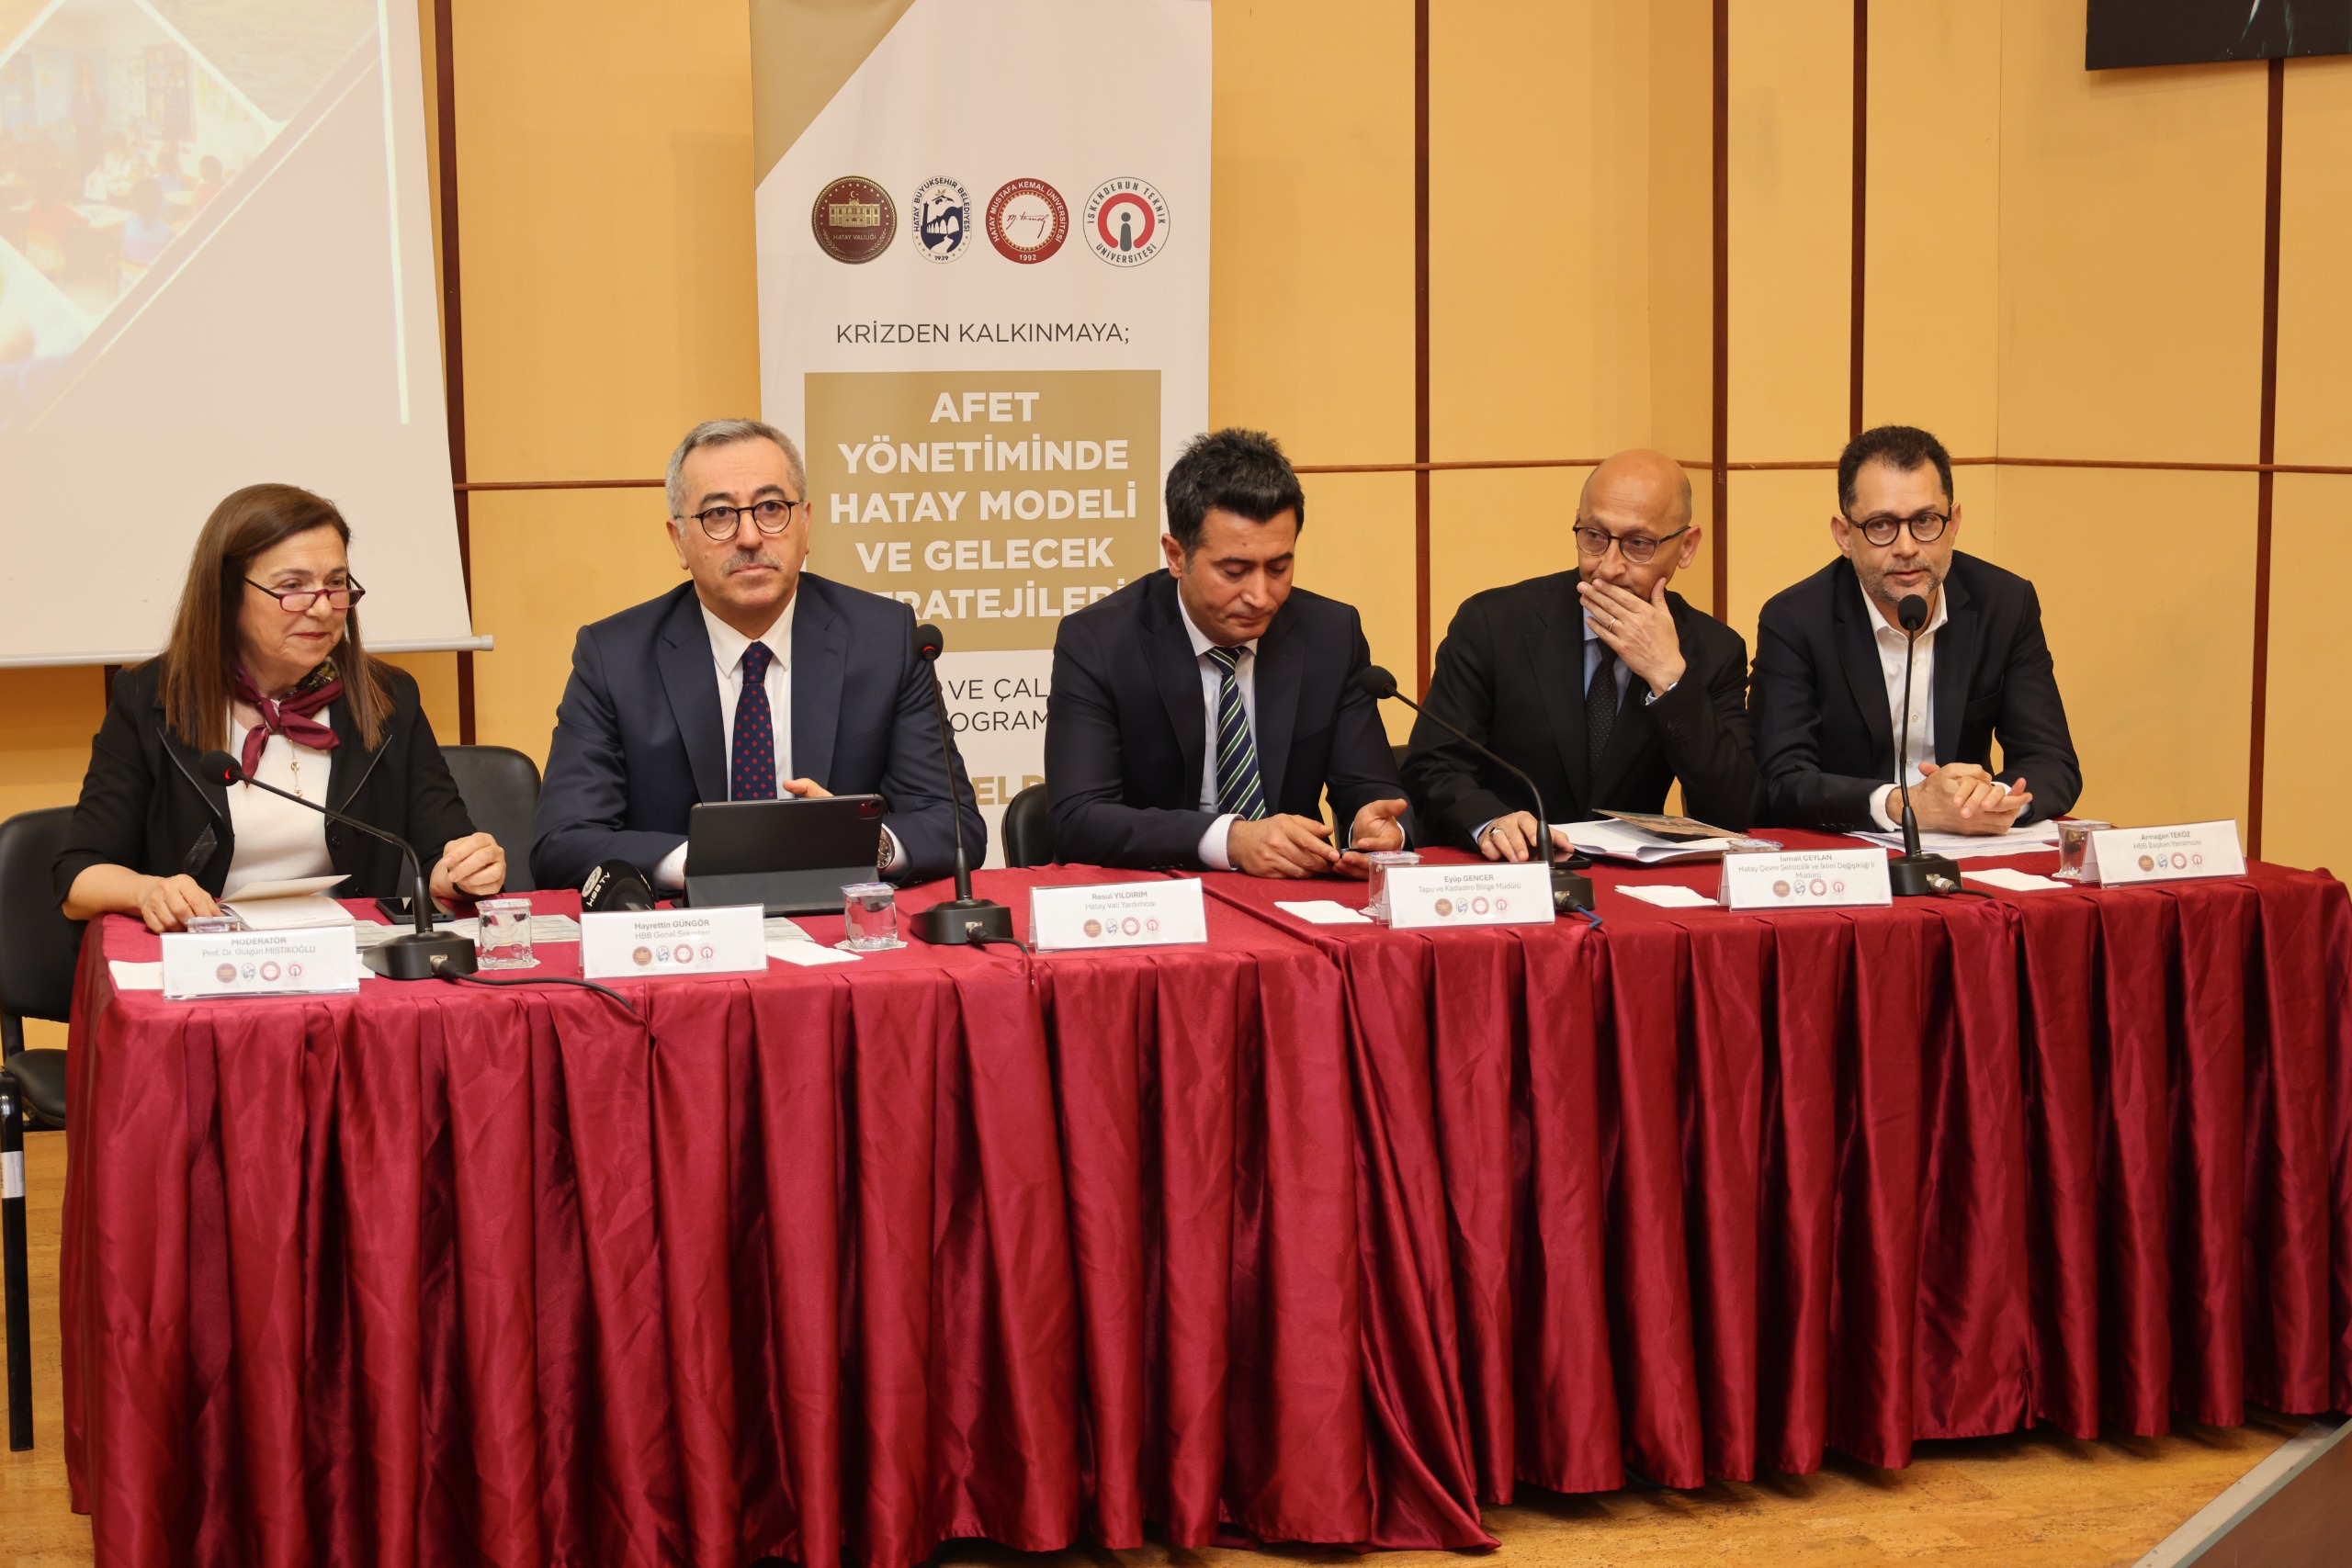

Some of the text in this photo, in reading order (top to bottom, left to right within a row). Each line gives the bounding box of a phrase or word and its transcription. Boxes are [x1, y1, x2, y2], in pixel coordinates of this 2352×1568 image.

[1018, 181, 1046, 193] KEMAL
[989, 184, 1018, 214] MUSTAFA
[989, 215, 1001, 243] HATAY
[837, 320, 1130, 344] KRİZDEN KALKINMAYA;
[930, 391, 1040, 423] AFET
[837, 434, 1129, 476] YÖNETİMİNDE
[830, 481, 1137, 524] HATAY MODELİ
[854, 537, 1114, 573] VE GELECEK
[948, 678, 1048, 703] VE ÇAL
[950, 710, 1048, 733] OGRAM
[599, 871, 611, 884] TV
[1444, 875, 1462, 885] Eyüp
[1738, 865, 1758, 874] Hatay
[1114, 891, 1148, 899] YILDIRIM
[1444, 884, 1476, 892] Kadastro
[1476, 883, 1495, 892] Bölge
[634, 919, 710, 931] Hayrettin GÜNGÖR
[635, 931, 652, 940] HBB
